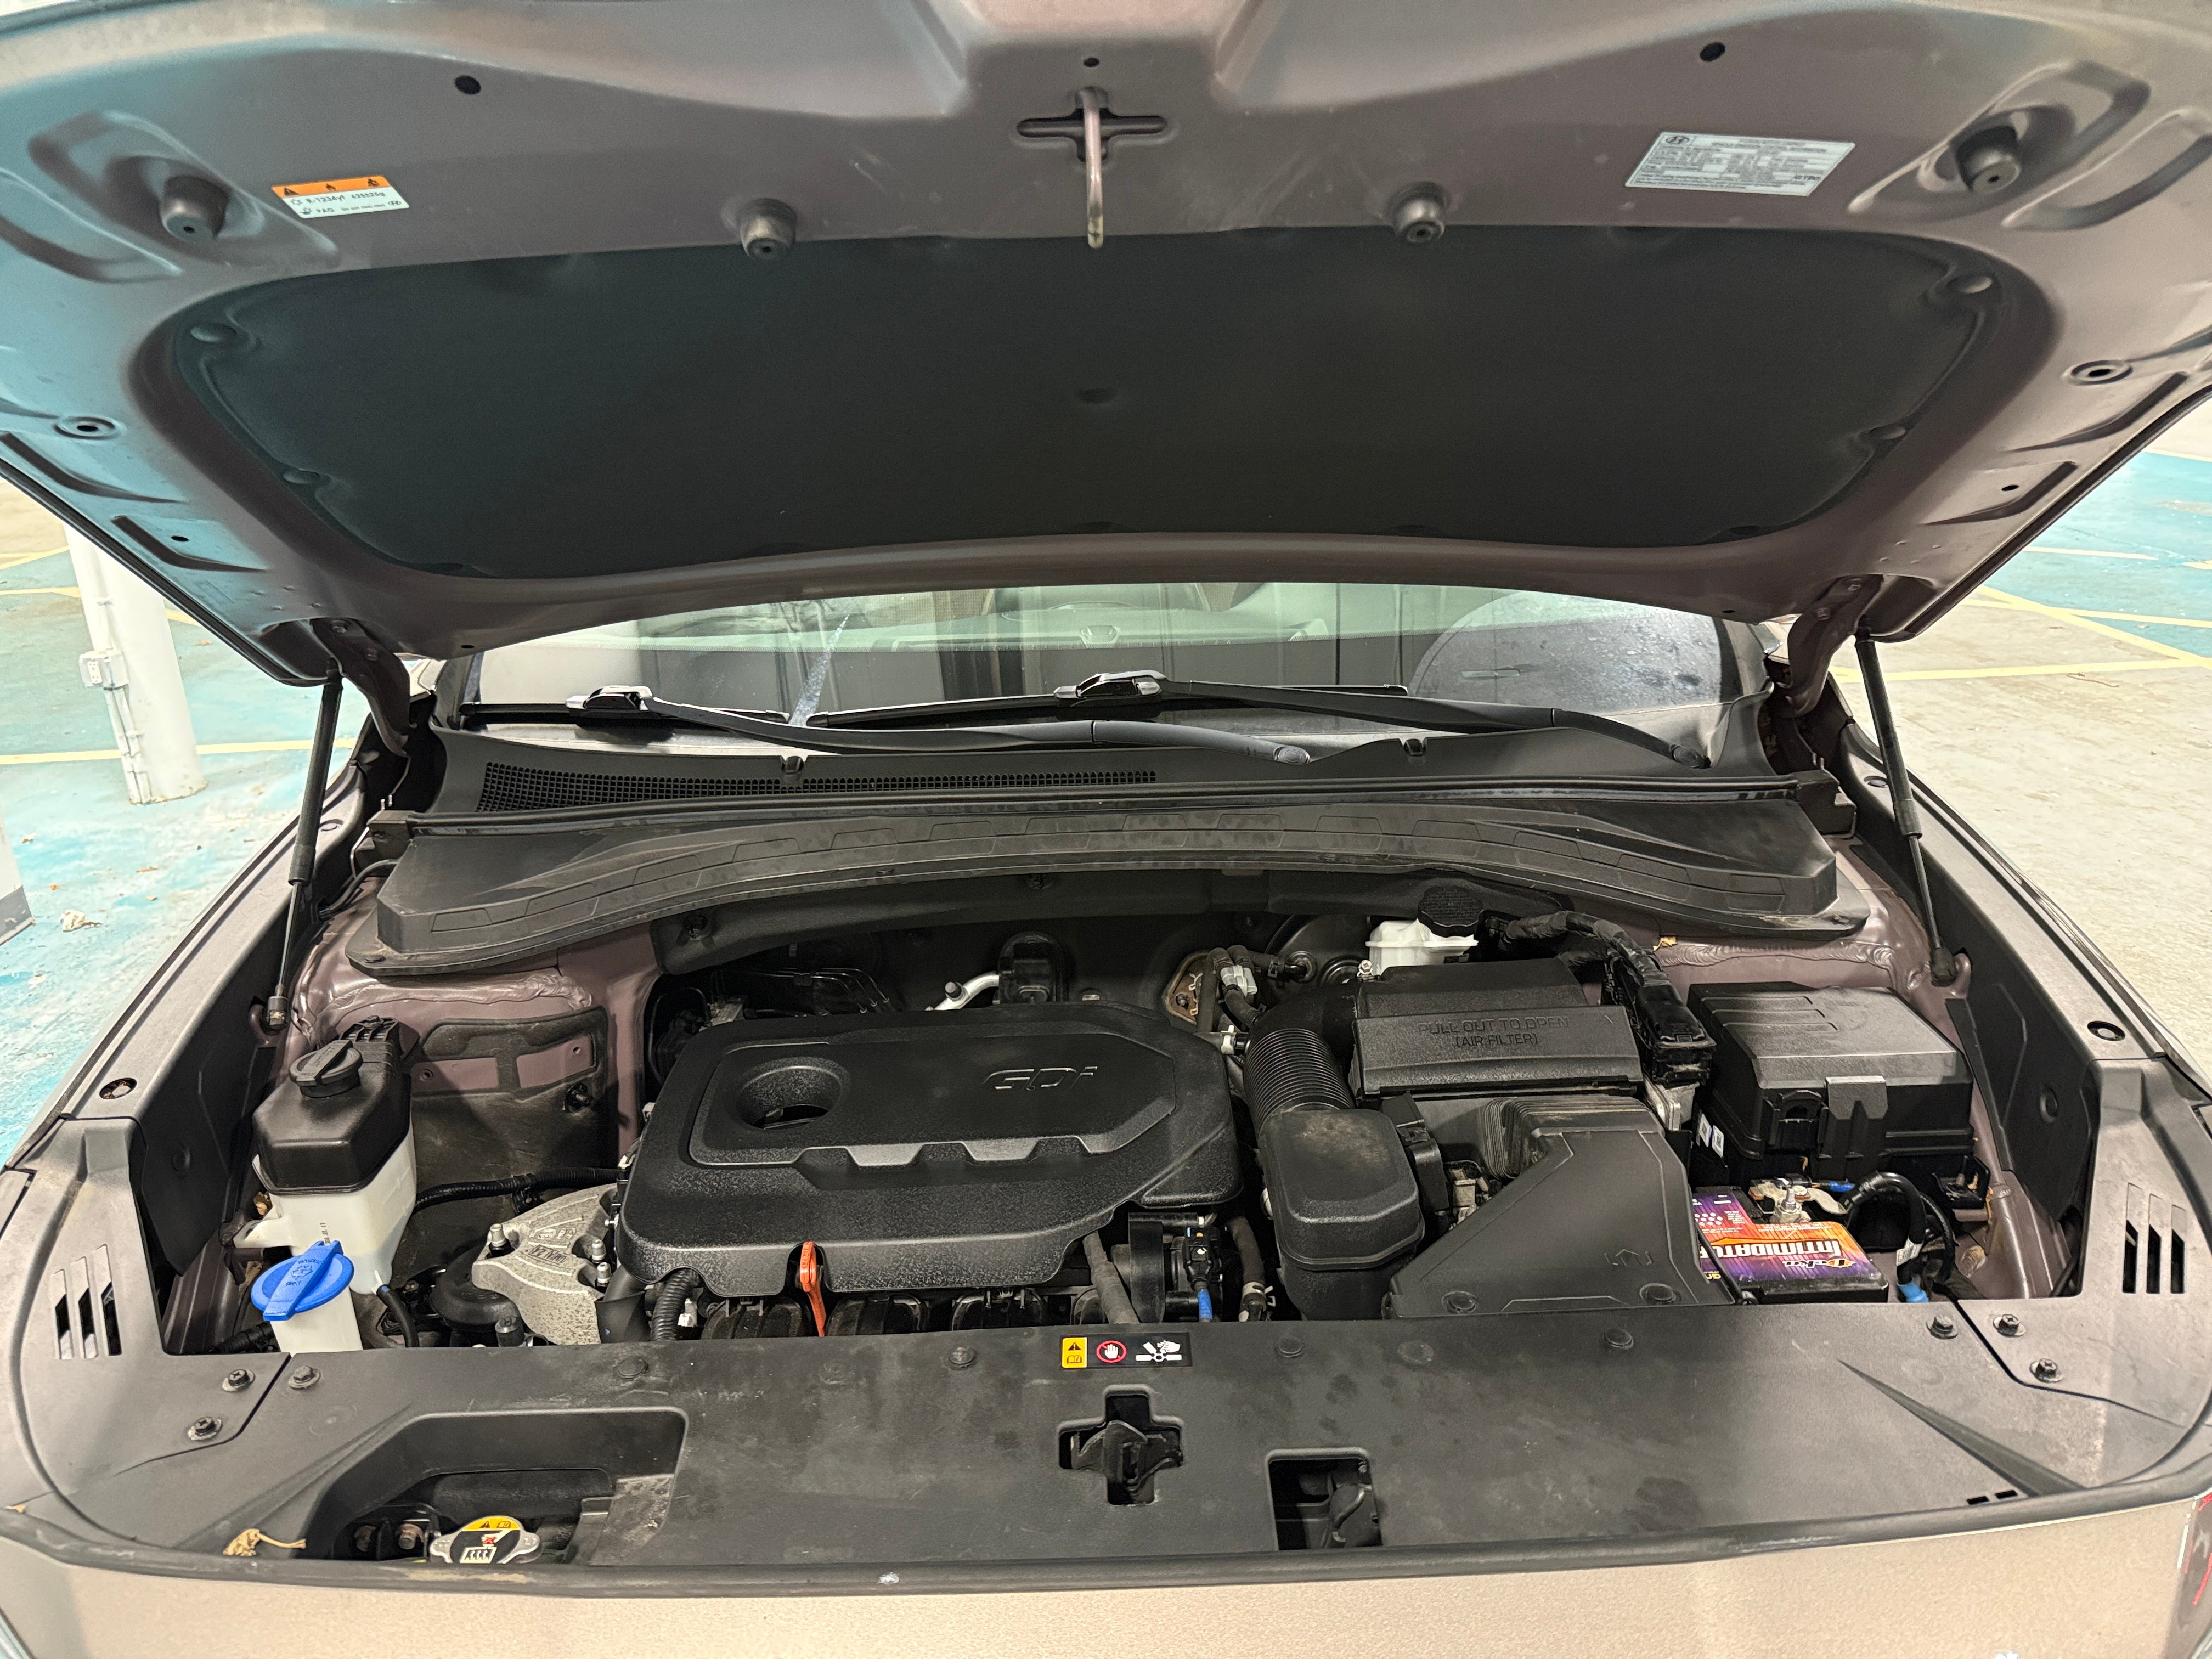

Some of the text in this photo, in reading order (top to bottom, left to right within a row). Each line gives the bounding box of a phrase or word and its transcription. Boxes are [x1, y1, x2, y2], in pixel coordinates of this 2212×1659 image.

[1417, 1015, 1570, 1035] PULL OUT TO OPEN
